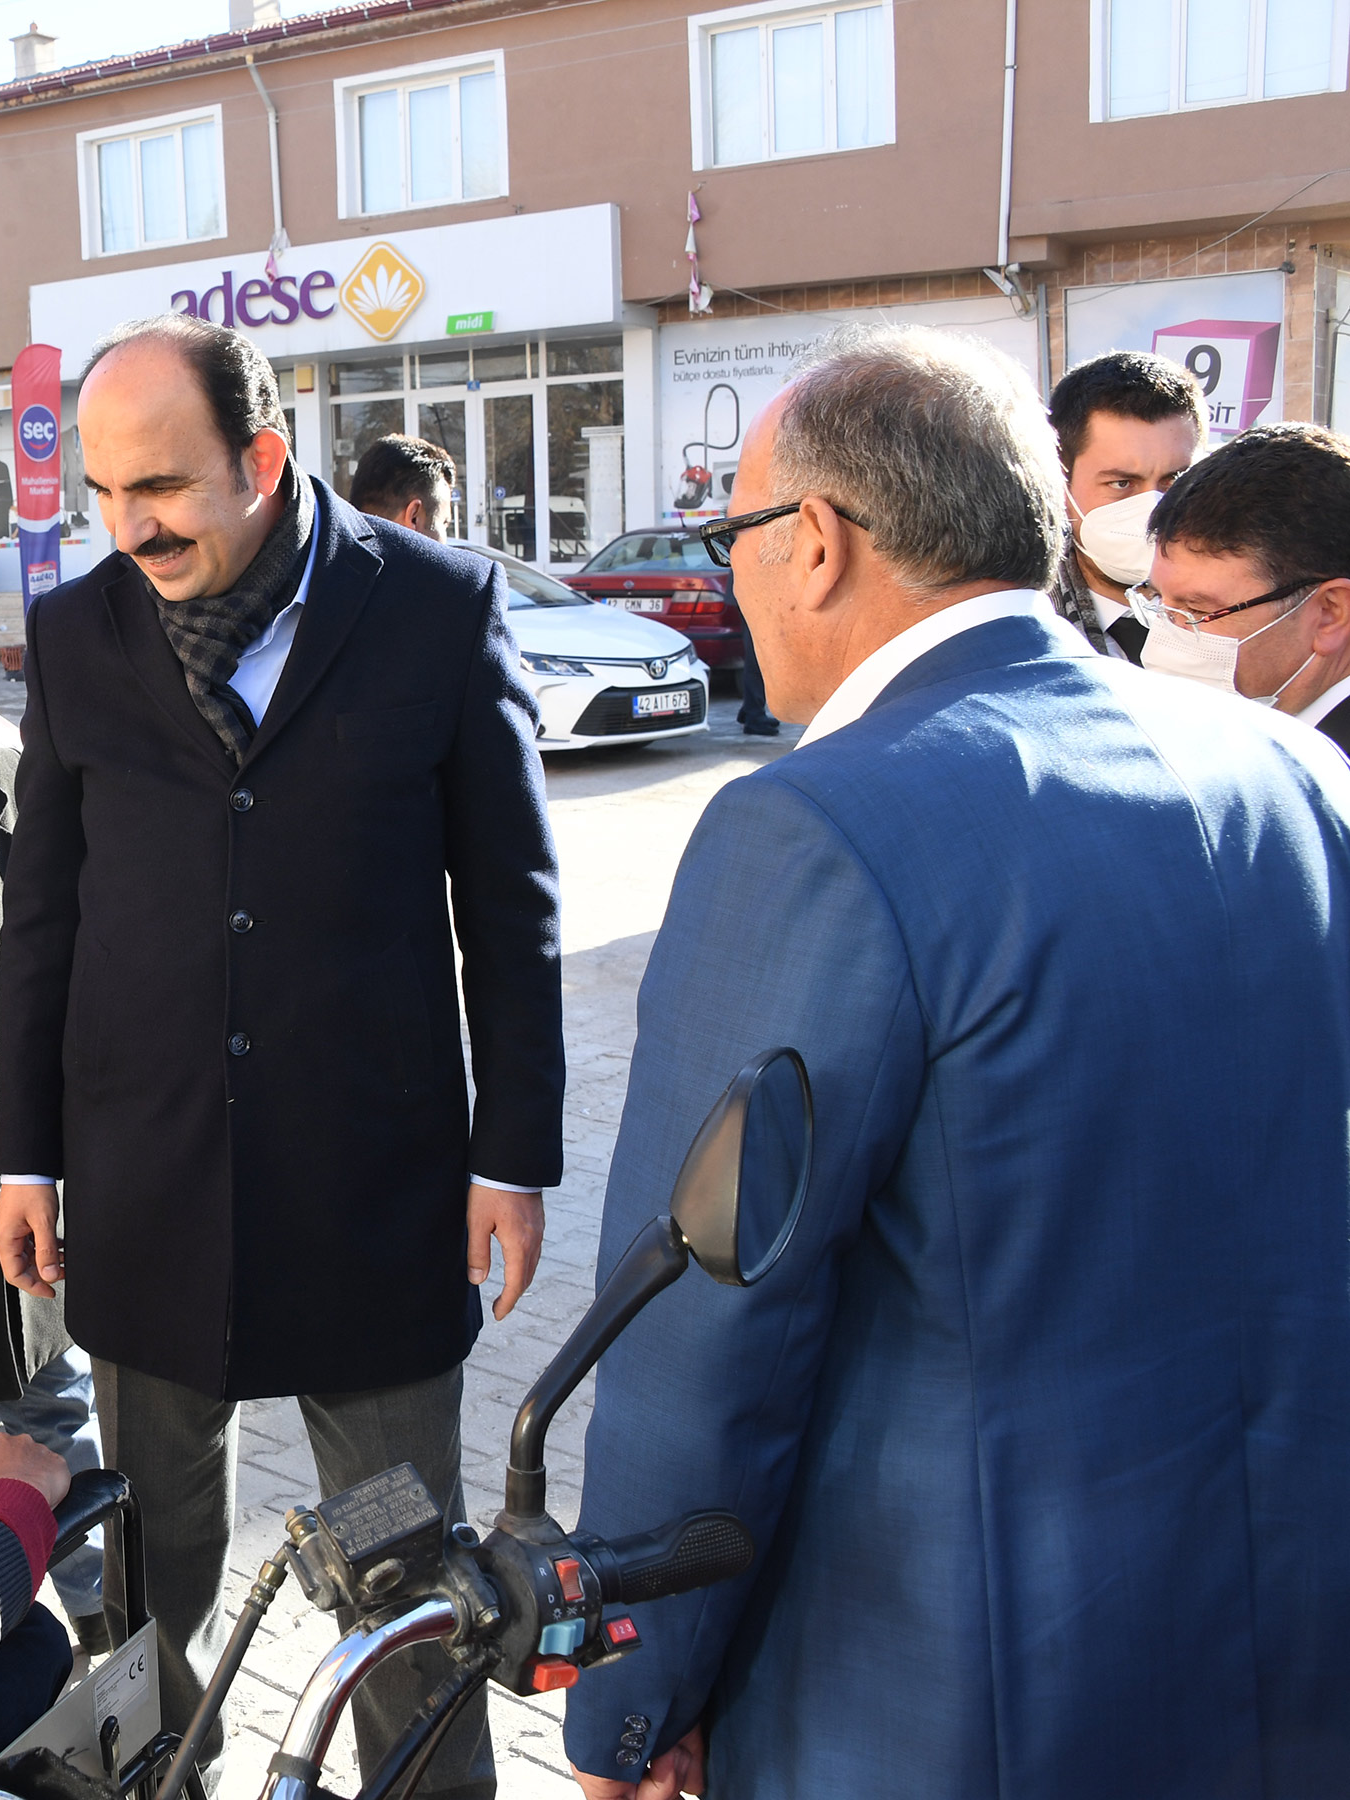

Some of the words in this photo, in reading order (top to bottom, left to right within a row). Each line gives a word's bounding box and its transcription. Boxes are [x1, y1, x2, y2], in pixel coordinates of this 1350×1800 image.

[170, 270, 336, 328] adese
[455, 315, 483, 331] midi
[673, 346, 731, 366] Evinizin
[735, 343, 764, 362] tüm
[673, 368, 701, 383] bütçe
[703, 367, 731, 381] dostu
[624, 600, 642, 610] CMN
[648, 600, 661, 610] 36
[638, 697, 650, 711] 42
[672, 692, 688, 708] 673
[538, 1567, 548, 1577] R
[547, 1594, 555, 1604] D
